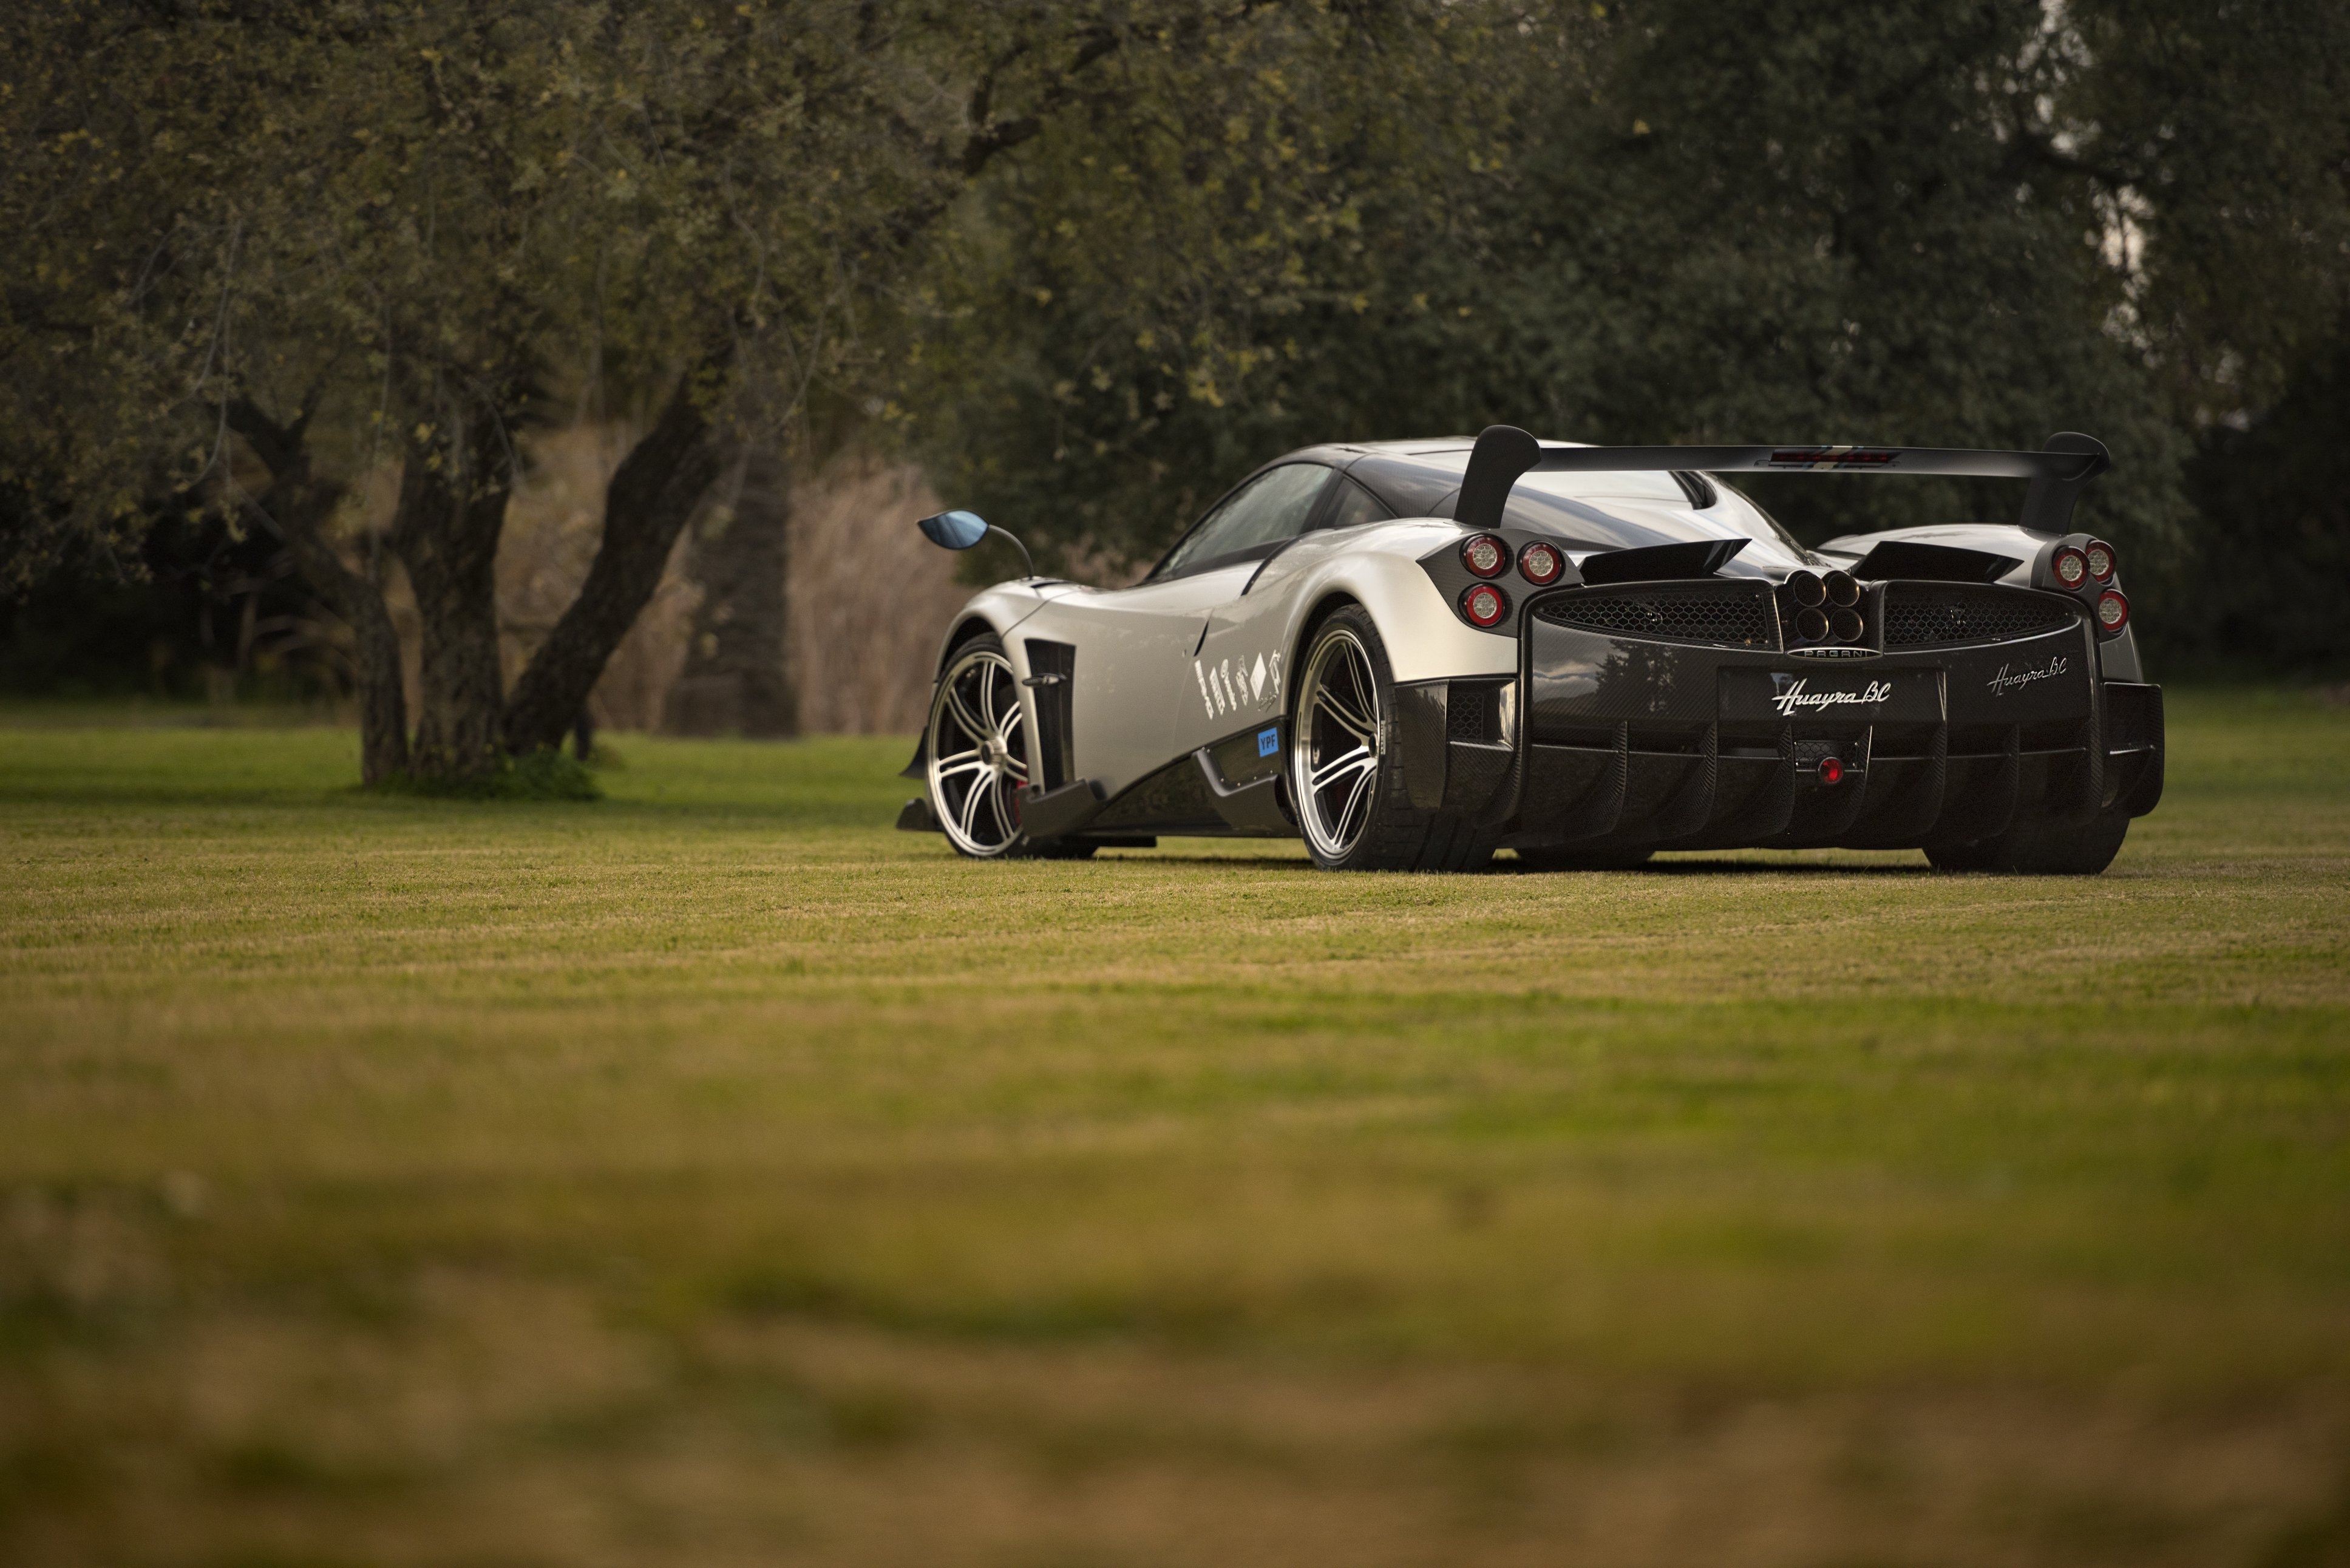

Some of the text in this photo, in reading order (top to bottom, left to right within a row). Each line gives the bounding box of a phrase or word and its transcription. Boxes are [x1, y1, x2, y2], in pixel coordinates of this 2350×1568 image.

[1987, 656, 2067, 697] Huayra BC
[1771, 678, 1891, 716] Huayra BC
[1260, 734, 1275, 750] YPF
